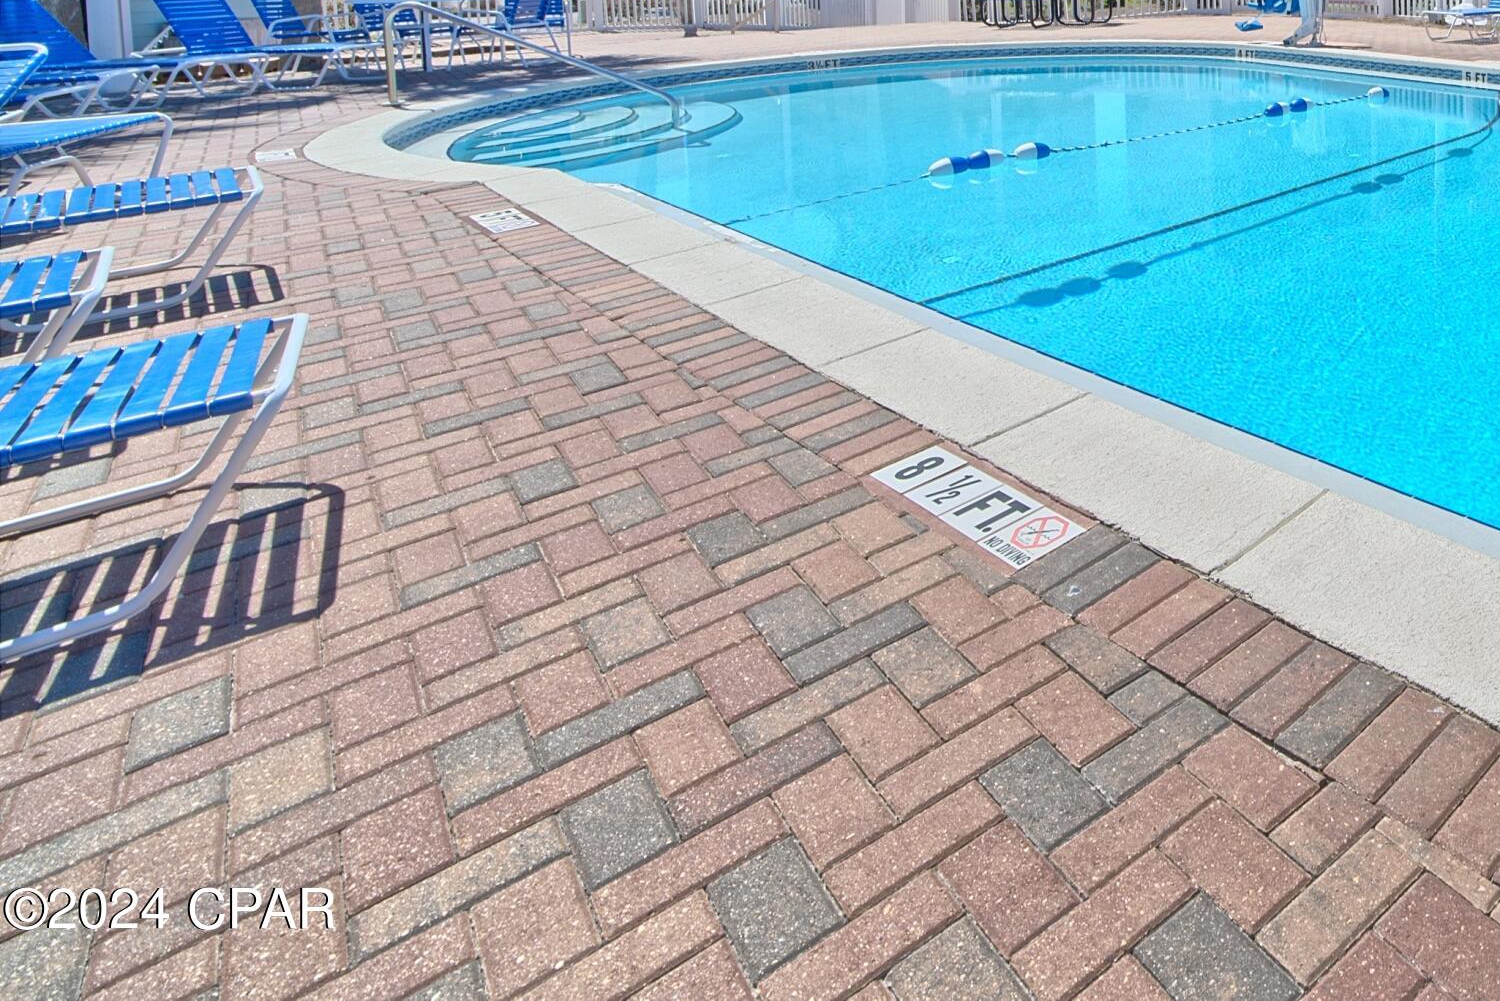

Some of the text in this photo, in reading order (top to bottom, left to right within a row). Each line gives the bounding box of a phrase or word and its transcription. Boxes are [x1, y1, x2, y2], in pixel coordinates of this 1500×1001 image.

[1246, 50, 1254, 58] FT
[824, 58, 838, 68] FT
[1466, 72, 1486, 83] 5 FT
[894, 456, 945, 480] 8
[953, 489, 1032, 534] FT.
[984, 536, 1033, 565] NO DIVING
